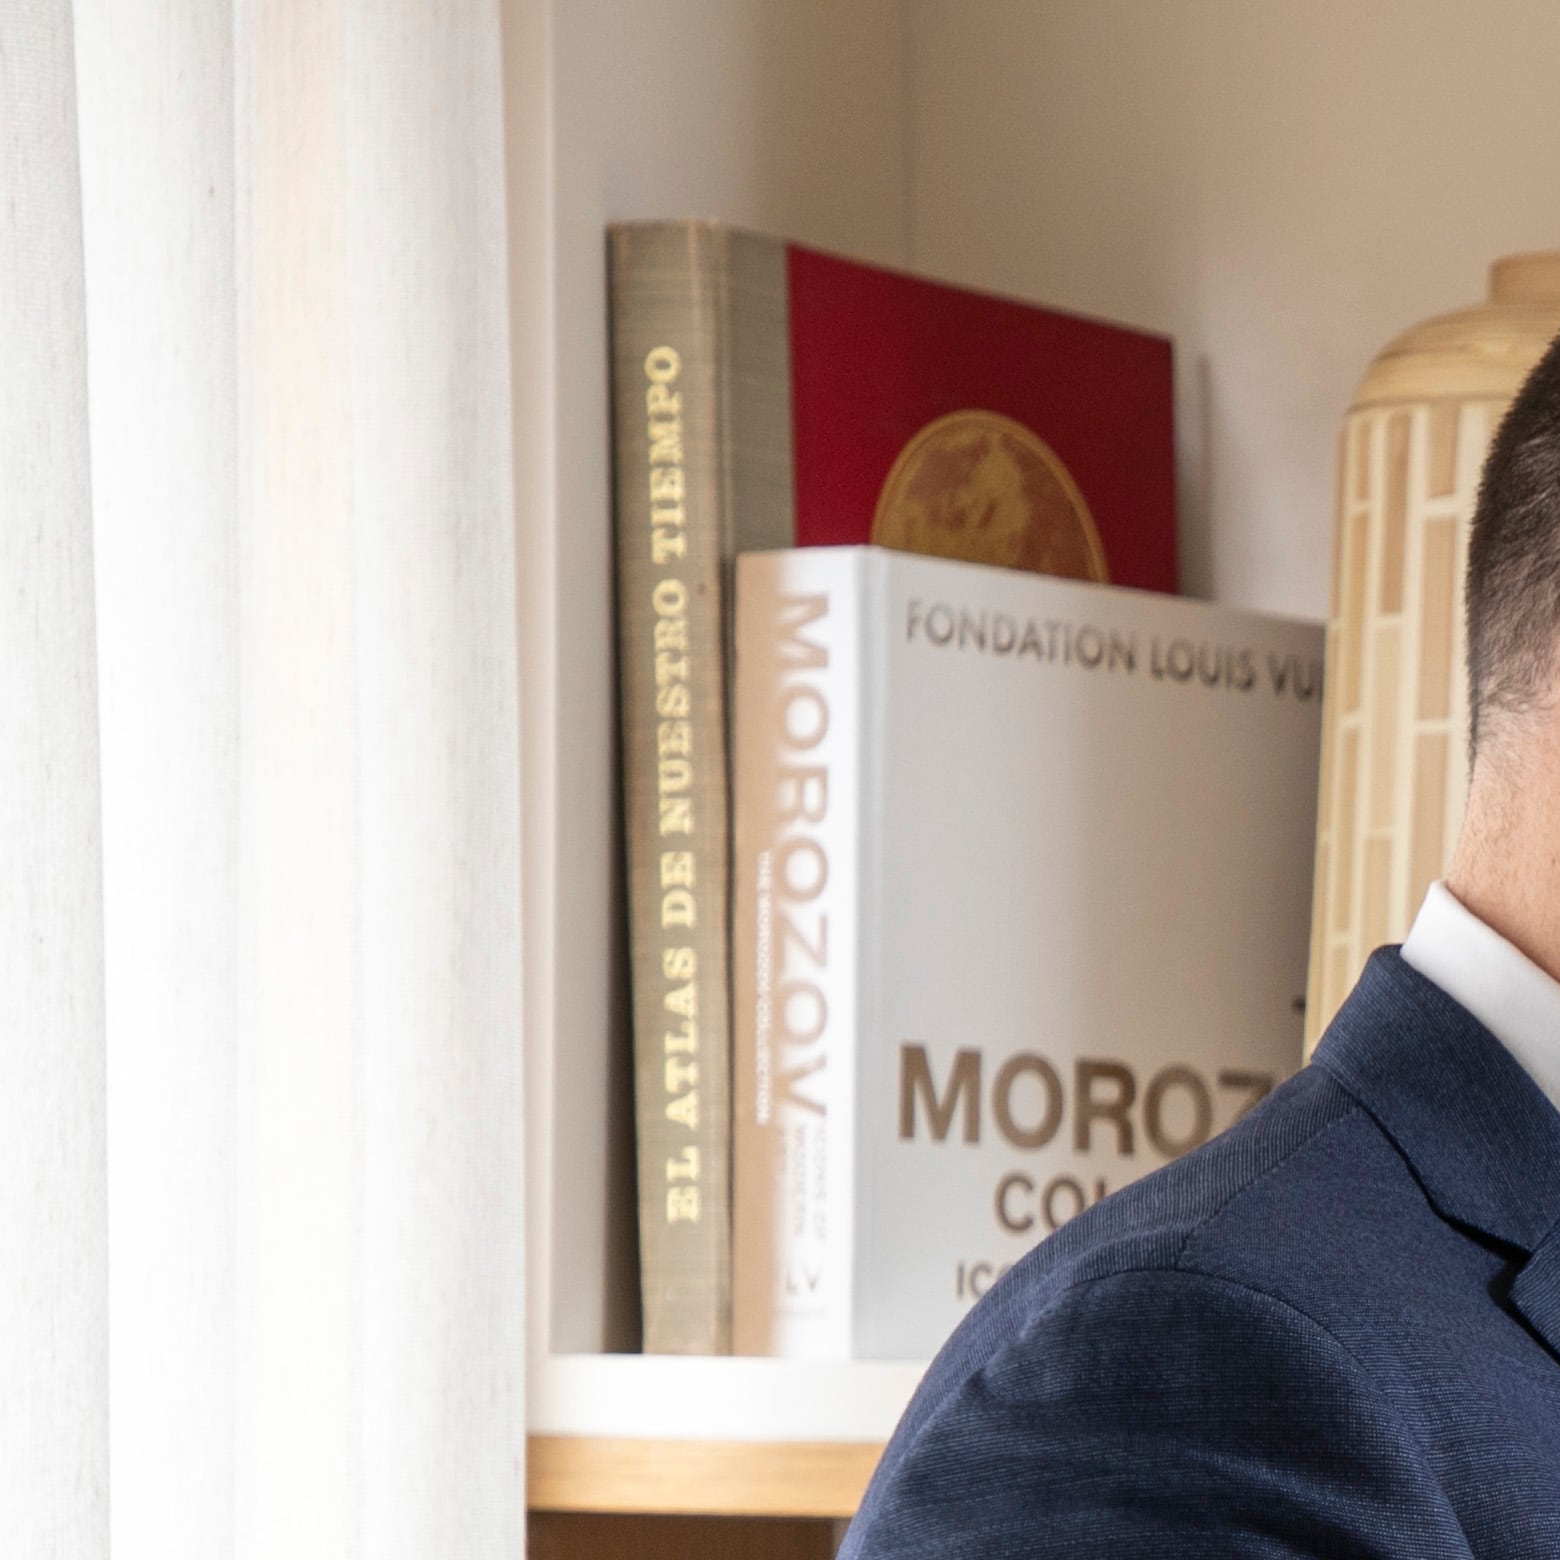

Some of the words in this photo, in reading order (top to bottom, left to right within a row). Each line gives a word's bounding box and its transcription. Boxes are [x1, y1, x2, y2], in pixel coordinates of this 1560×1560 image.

[644, 346, 688, 564] TIEMPO
[652, 578, 695, 838] NUESTRO
[905, 599, 1136, 675] FONDATION
[1149, 633, 1254, 692] LOUIS
[660, 851, 696, 929] DE
[774, 590, 830, 1117] MOROZOV
[661, 946, 699, 1131] ATLAS
[899, 1043, 1276, 1158] MOROZ
[666, 1146, 700, 1224] EL
